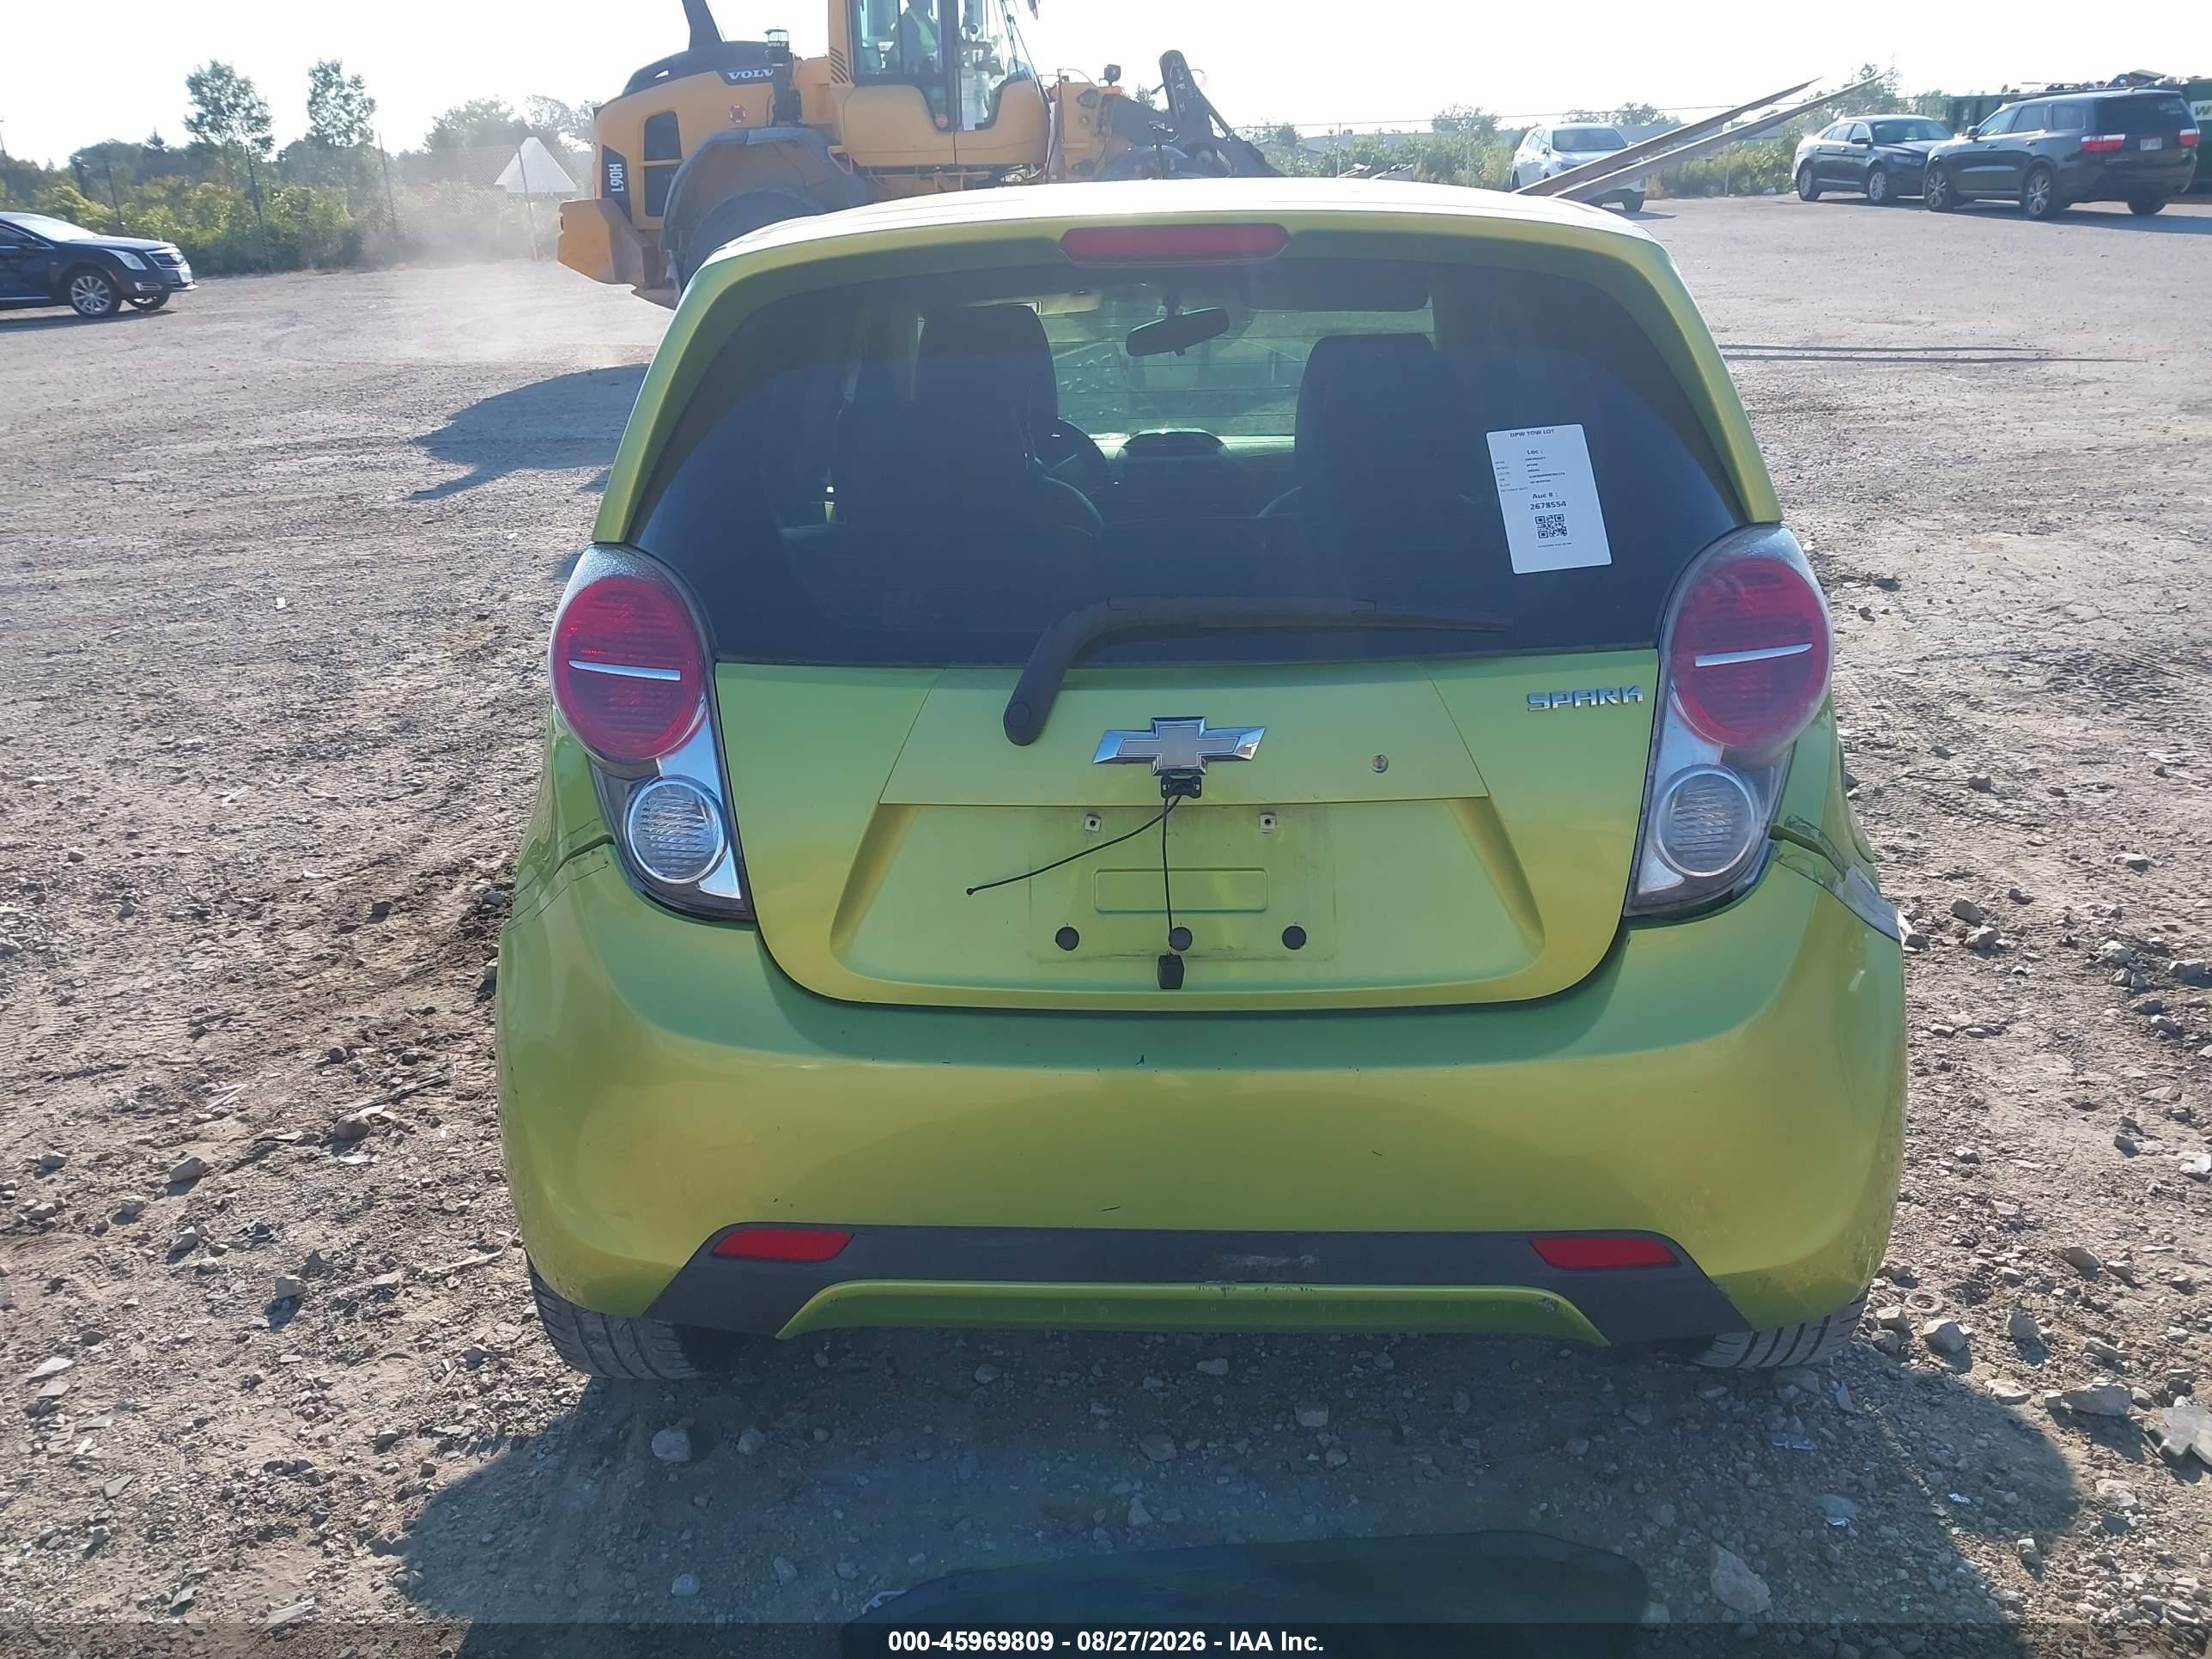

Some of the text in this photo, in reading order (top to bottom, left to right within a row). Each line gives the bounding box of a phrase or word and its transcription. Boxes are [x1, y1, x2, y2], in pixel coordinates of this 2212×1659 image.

[727, 69, 775, 80] VOLV
[608, 163, 624, 192] L90H
[1529, 501, 1567, 510] 2678554
[1528, 685, 1644, 711] SPARK
